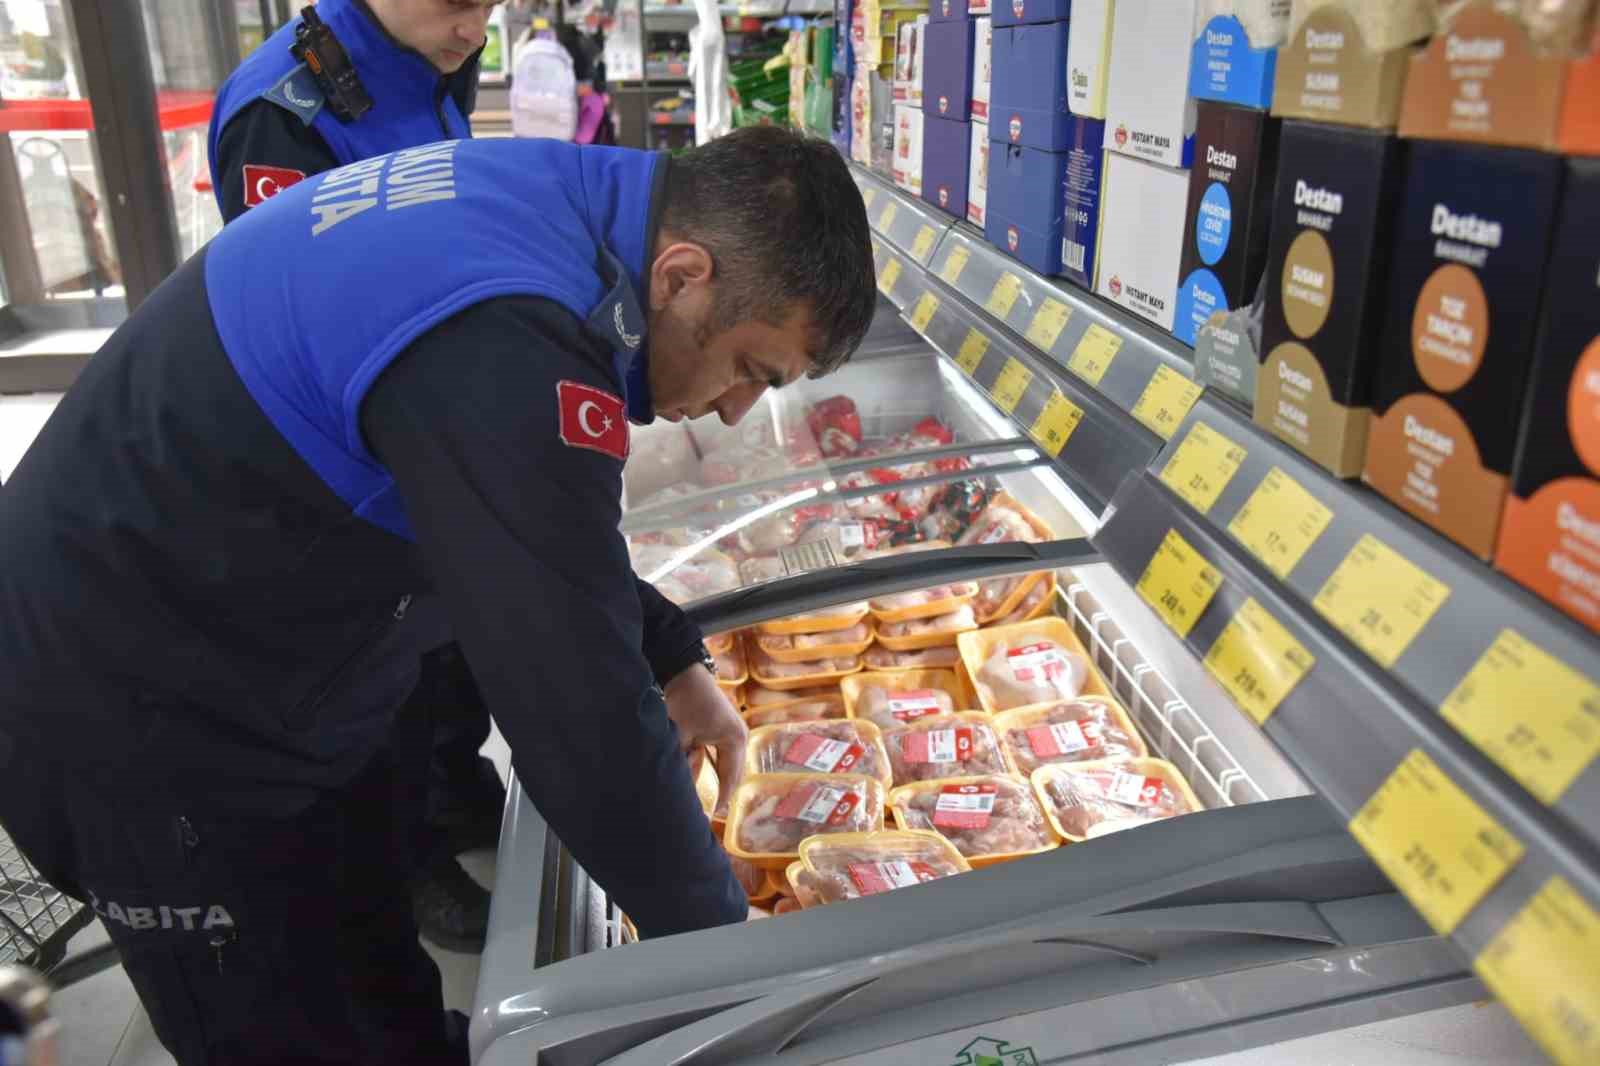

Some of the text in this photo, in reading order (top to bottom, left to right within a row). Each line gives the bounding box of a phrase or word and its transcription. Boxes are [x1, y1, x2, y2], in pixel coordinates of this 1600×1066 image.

[1206, 144, 1238, 169] Destan
[1294, 179, 1343, 215] Destan
[1431, 203, 1503, 248] Destan
[1125, 285, 1148, 303] INSTANT
